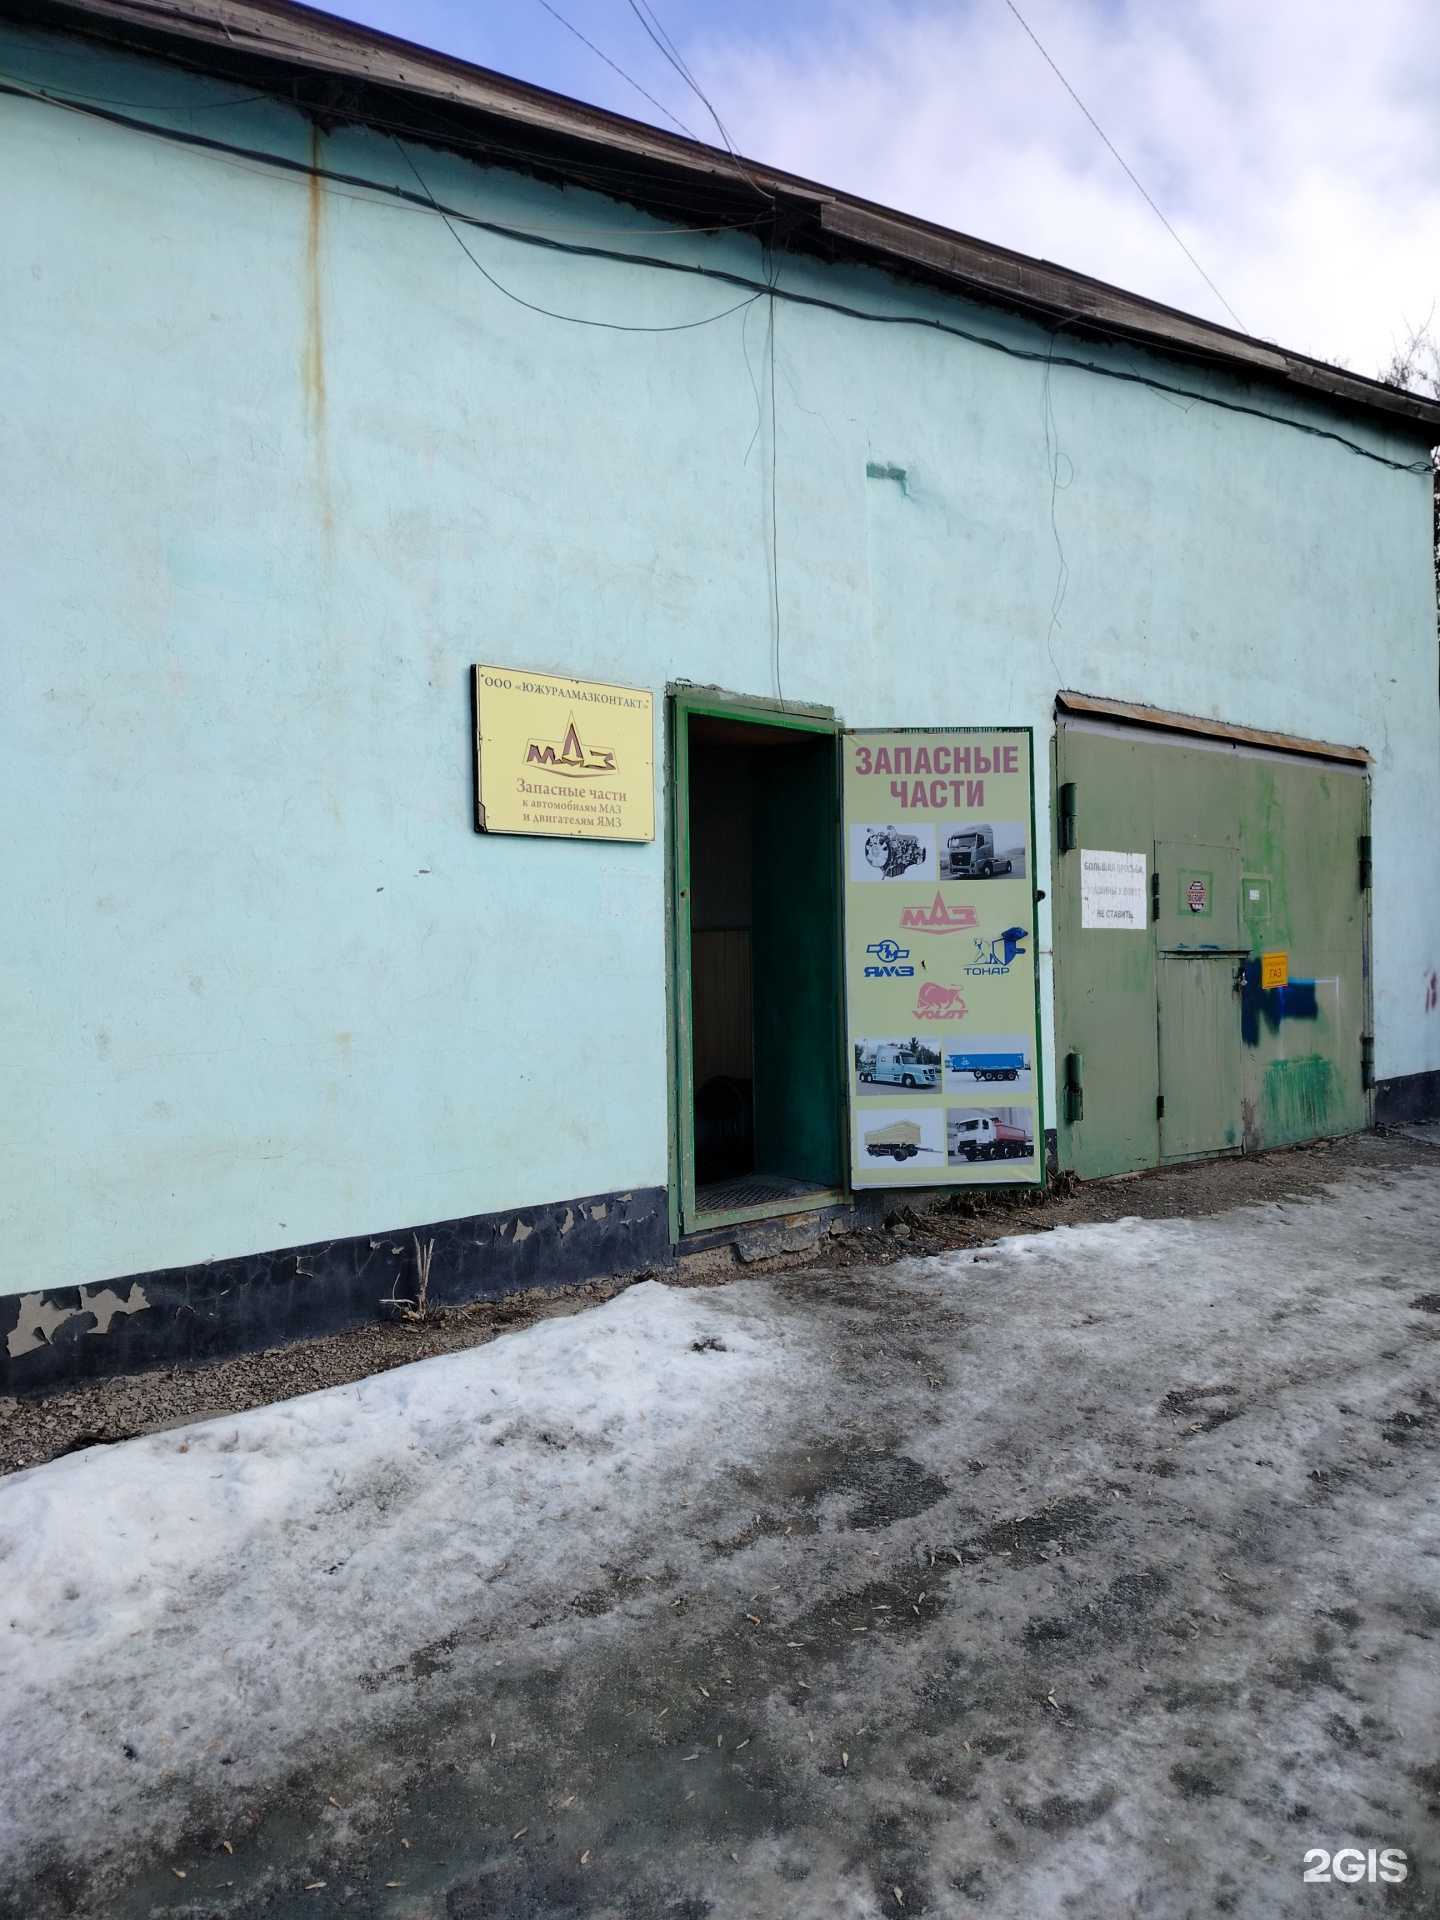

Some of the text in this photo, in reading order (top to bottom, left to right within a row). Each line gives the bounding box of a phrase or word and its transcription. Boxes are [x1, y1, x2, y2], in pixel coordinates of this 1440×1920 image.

[484, 676, 512, 690] ООО
[526, 722, 617, 770] МАЗ
[855, 746, 1019, 775] ЗАПАСНЫЕ
[516, 777, 628, 802] Запасные части
[890, 780, 985, 808] ЧАСТИ
[522, 799, 622, 815] к автомобилям МАЗ
[523, 813, 622, 828] и двигателям ЯМЗ
[901, 890, 977, 926] МАЗ
[864, 966, 915, 978] ЯМЗ
[963, 967, 1010, 976] ТОНАР
